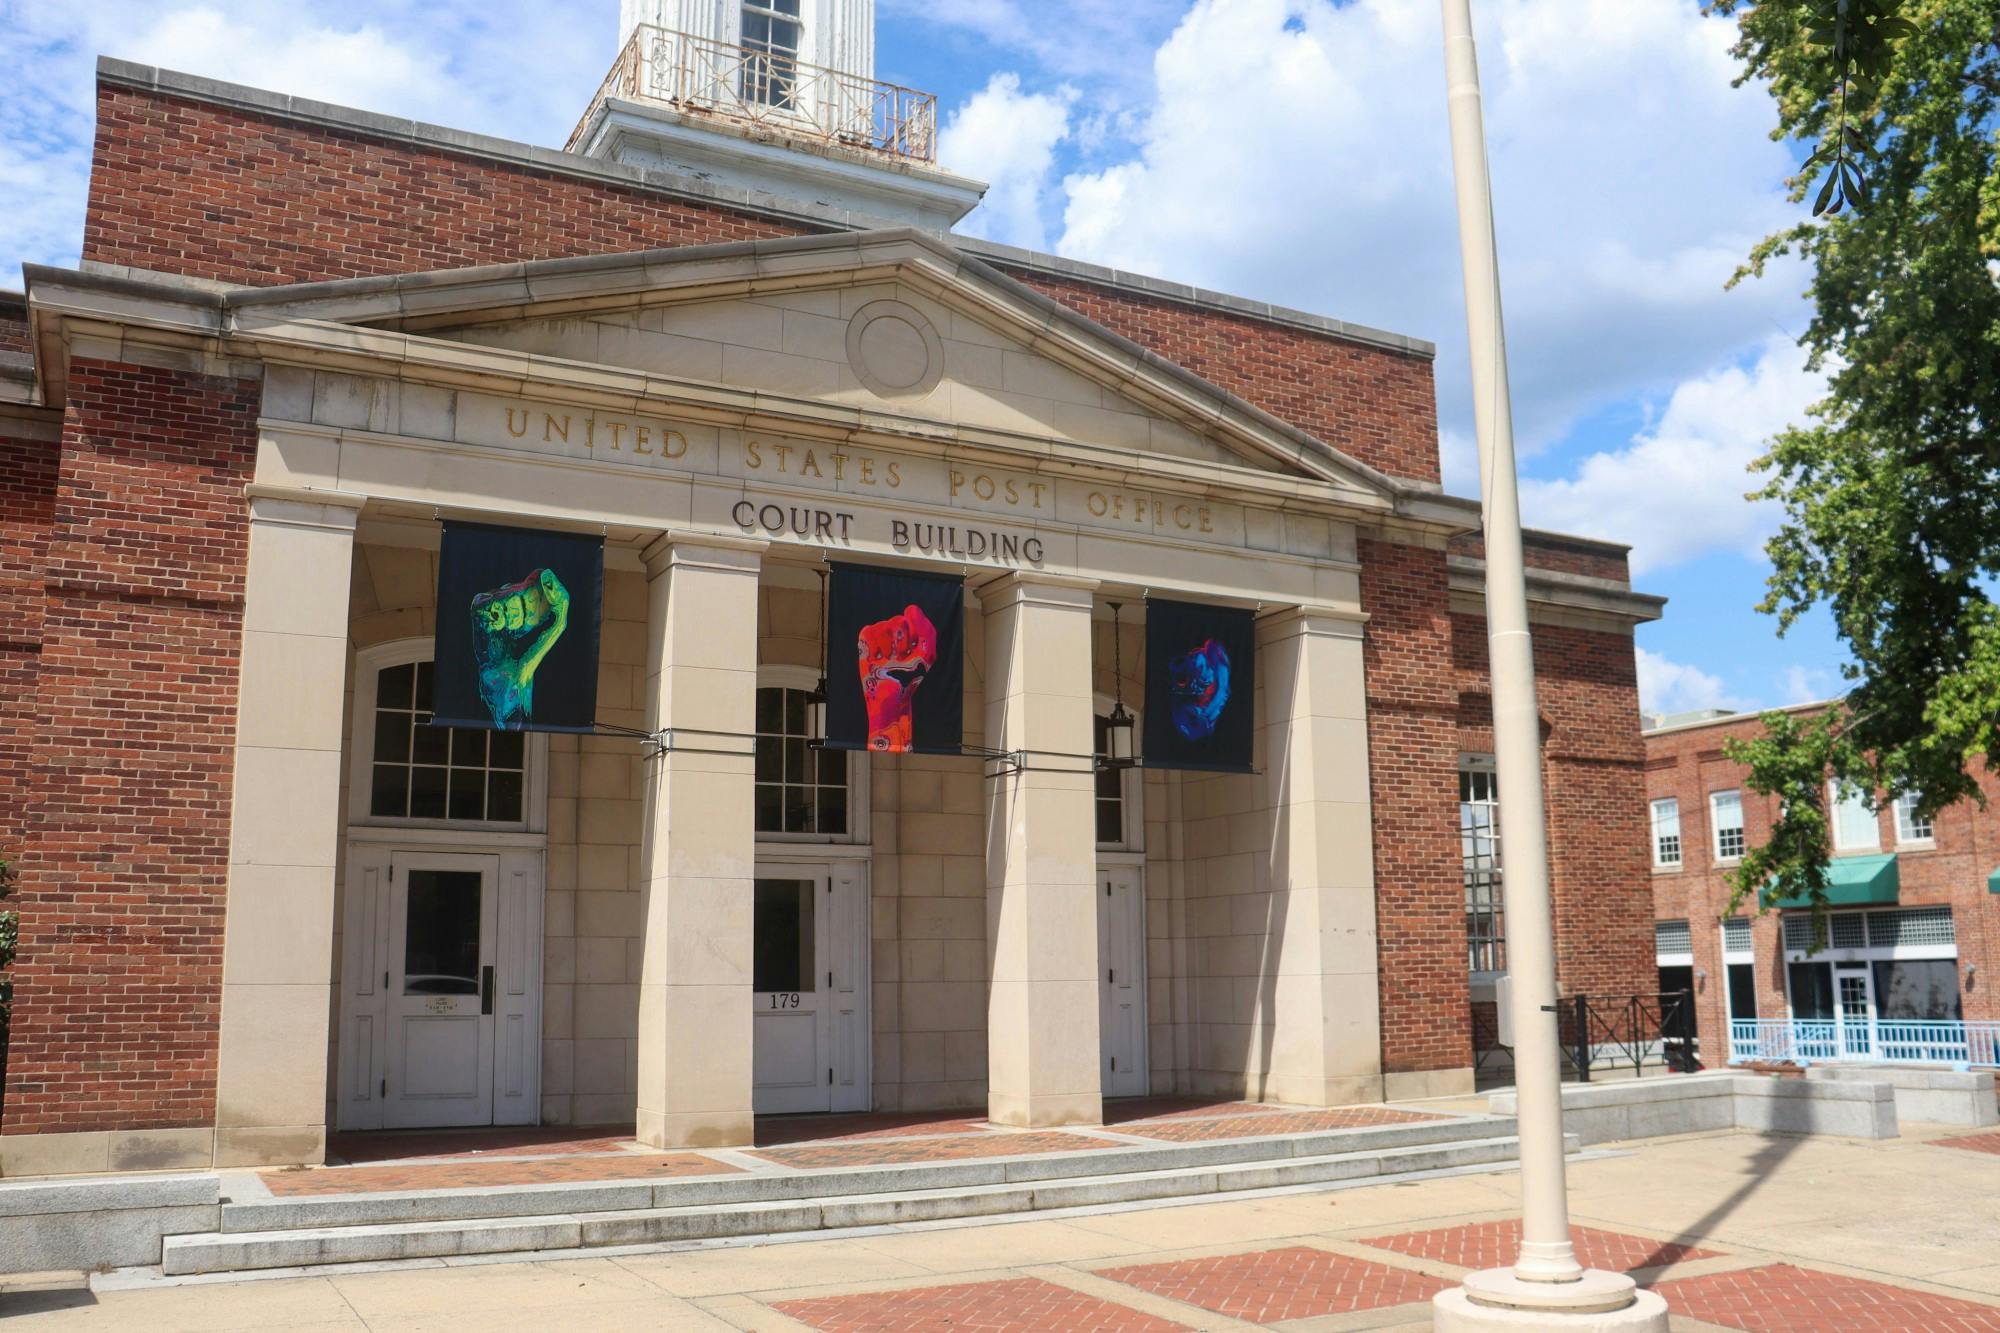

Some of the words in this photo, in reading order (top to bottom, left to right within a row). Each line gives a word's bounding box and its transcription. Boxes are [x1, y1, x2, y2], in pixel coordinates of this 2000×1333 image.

[506, 408, 688, 458] UNITED
[746, 441, 901, 488] STATES
[950, 470, 1047, 508] POST
[1087, 491, 1214, 533] OFFICE
[732, 500, 853, 541] COURT
[892, 521, 1043, 562] BUILDING
[770, 992, 800, 1009] 179
